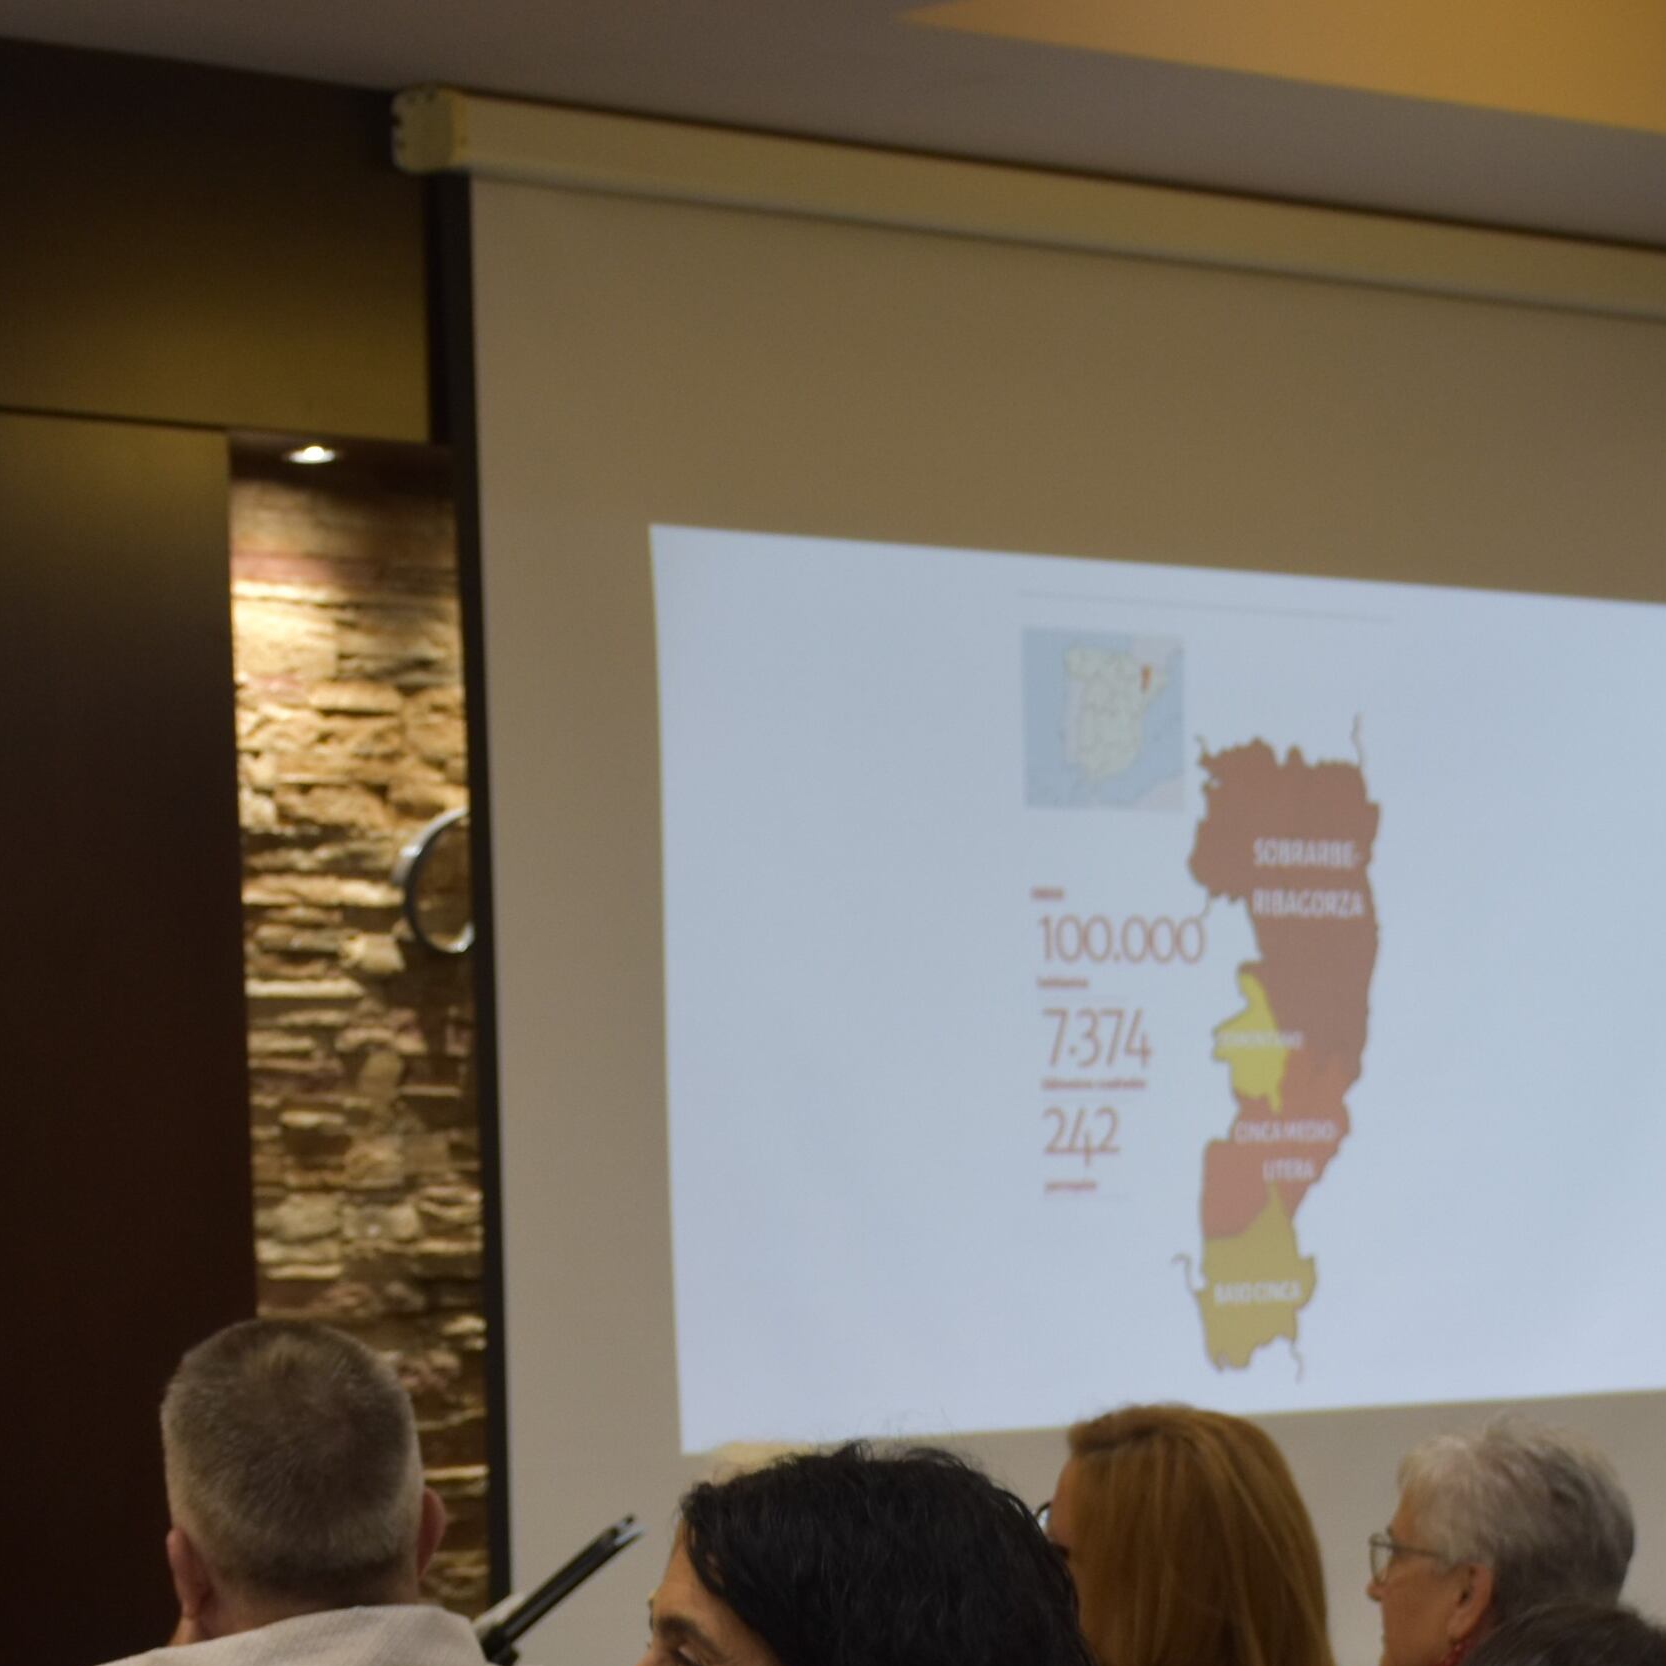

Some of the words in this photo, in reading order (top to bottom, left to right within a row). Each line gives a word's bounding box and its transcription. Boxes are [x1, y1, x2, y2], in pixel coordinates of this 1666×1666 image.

[1252, 887, 1365, 919] RIBAGORZA
[1039, 914, 1208, 965] 100.000
[1042, 1006, 1153, 1068] 7.374
[1042, 1105, 1121, 1167] 242
[1263, 1158, 1314, 1182] LITERA
